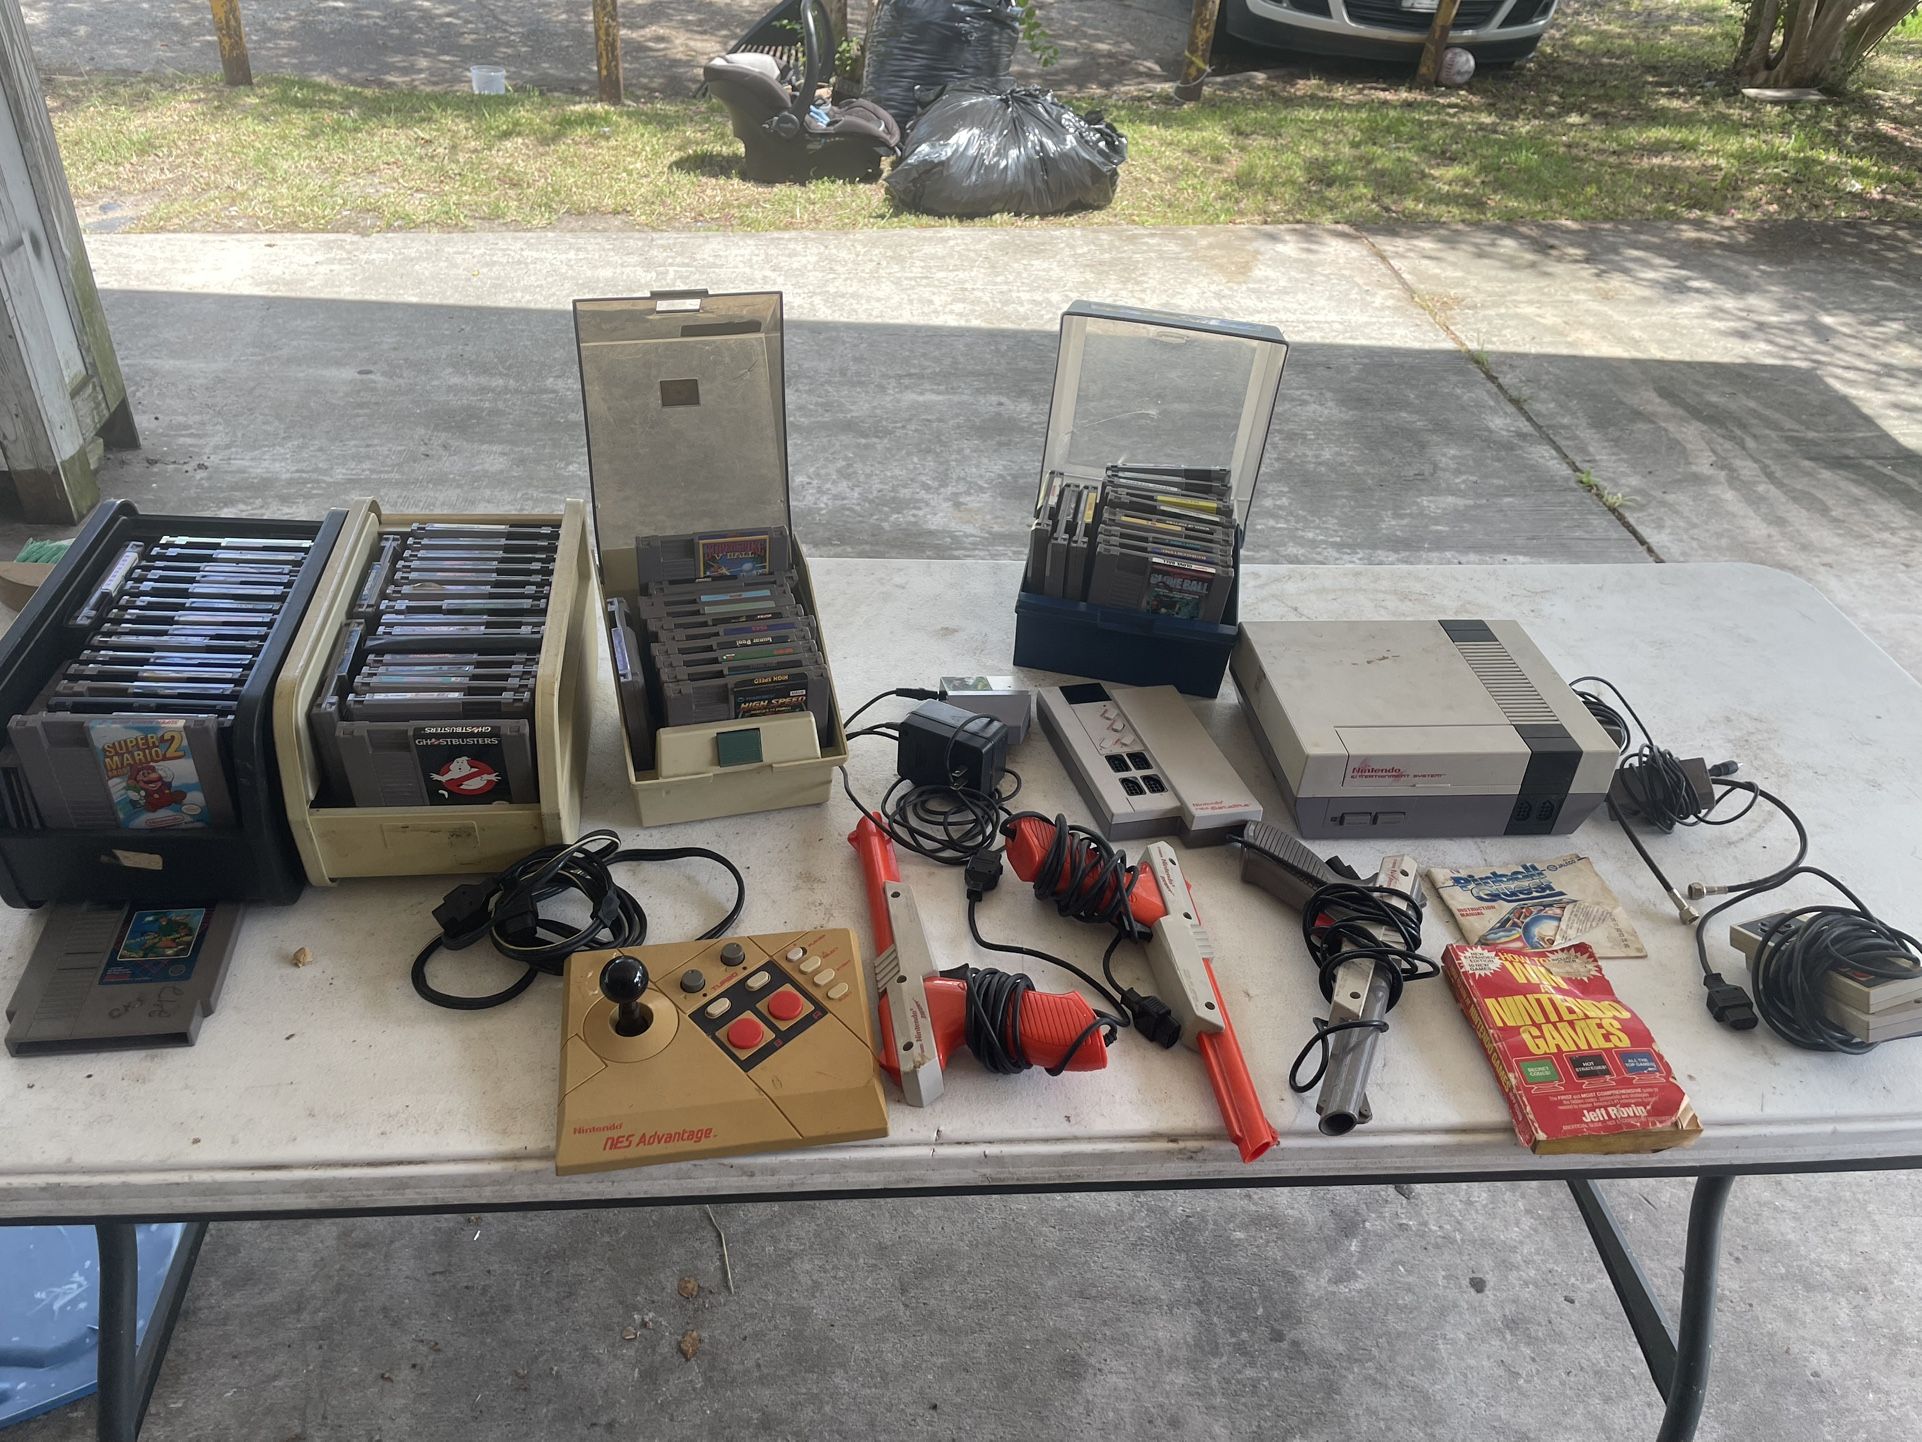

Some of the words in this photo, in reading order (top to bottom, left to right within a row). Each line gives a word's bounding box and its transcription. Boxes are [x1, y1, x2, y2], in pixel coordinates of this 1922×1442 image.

[740, 700, 769, 711] HIGH
[771, 696, 807, 707] SPEED
[102, 732, 160, 757] SUPER
[104, 747, 163, 771] MARIO
[159, 730, 186, 761] 2
[1351, 765, 1402, 775] Nintendo
[1450, 863, 1548, 891] Pinball
[1470, 881, 1566, 903] Quest
[1499, 952, 1531, 964] HOW
[1503, 961, 1569, 990] WIN
[1484, 993, 1632, 1027] NINTENDO
[1519, 1017, 1632, 1055] GAMES
[1582, 1106, 1609, 1122] Jeff
[1607, 1103, 1648, 1119] Rovin
[572, 1122, 624, 1135] Nintendo
[635, 1127, 714, 1148] Advantage
